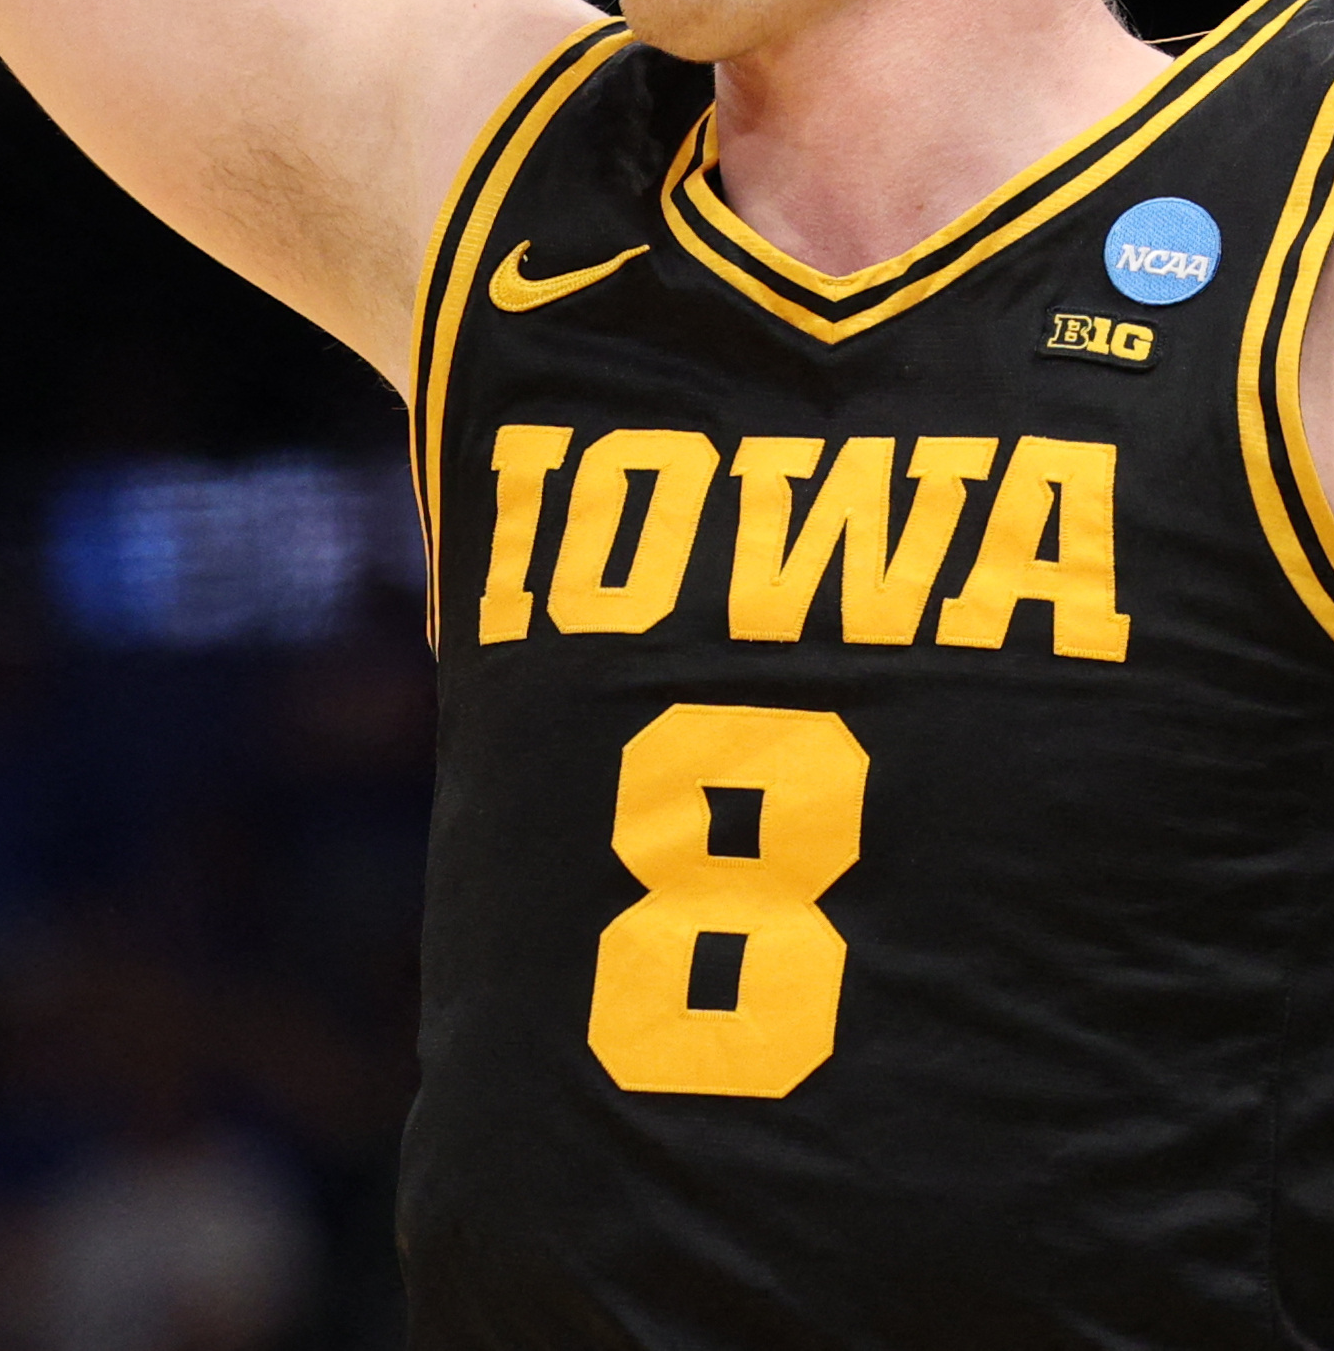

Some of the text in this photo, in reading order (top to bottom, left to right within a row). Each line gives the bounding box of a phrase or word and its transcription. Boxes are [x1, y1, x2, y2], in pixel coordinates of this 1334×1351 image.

[1116, 243, 1210, 282] NCAA
[478, 424, 1131, 663] IOWA
[587, 703, 870, 1099] 8
